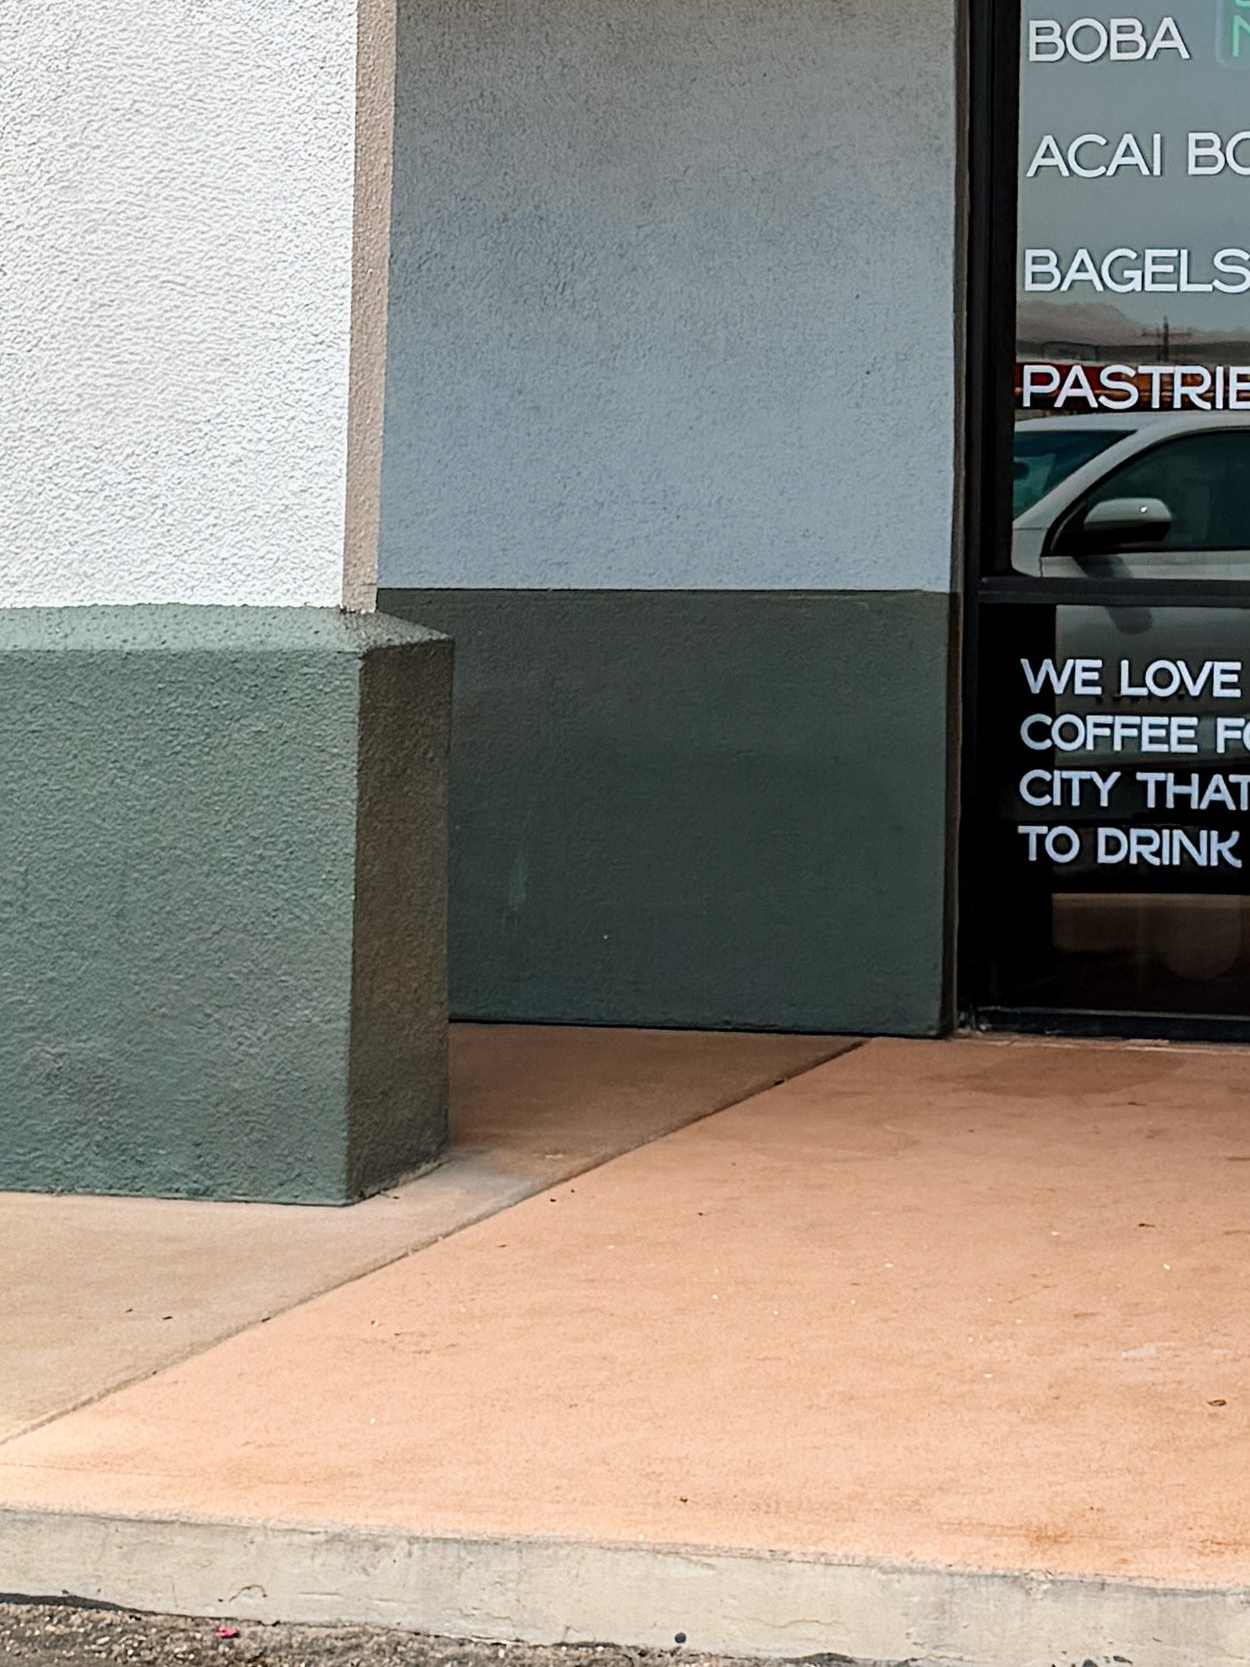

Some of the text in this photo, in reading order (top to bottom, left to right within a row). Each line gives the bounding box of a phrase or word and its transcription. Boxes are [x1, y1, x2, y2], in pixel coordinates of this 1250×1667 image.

[1028, 16, 1191, 63] BOBA
[1026, 133, 1162, 178] ACAI
[1020, 658, 1103, 696] WE
[1120, 659, 1242, 699] LOVE
[1020, 714, 1199, 754] COFFEE
[1019, 769, 1122, 808] CITY
[1017, 825, 1081, 864] TO
[1097, 826, 1243, 869] DRINK
